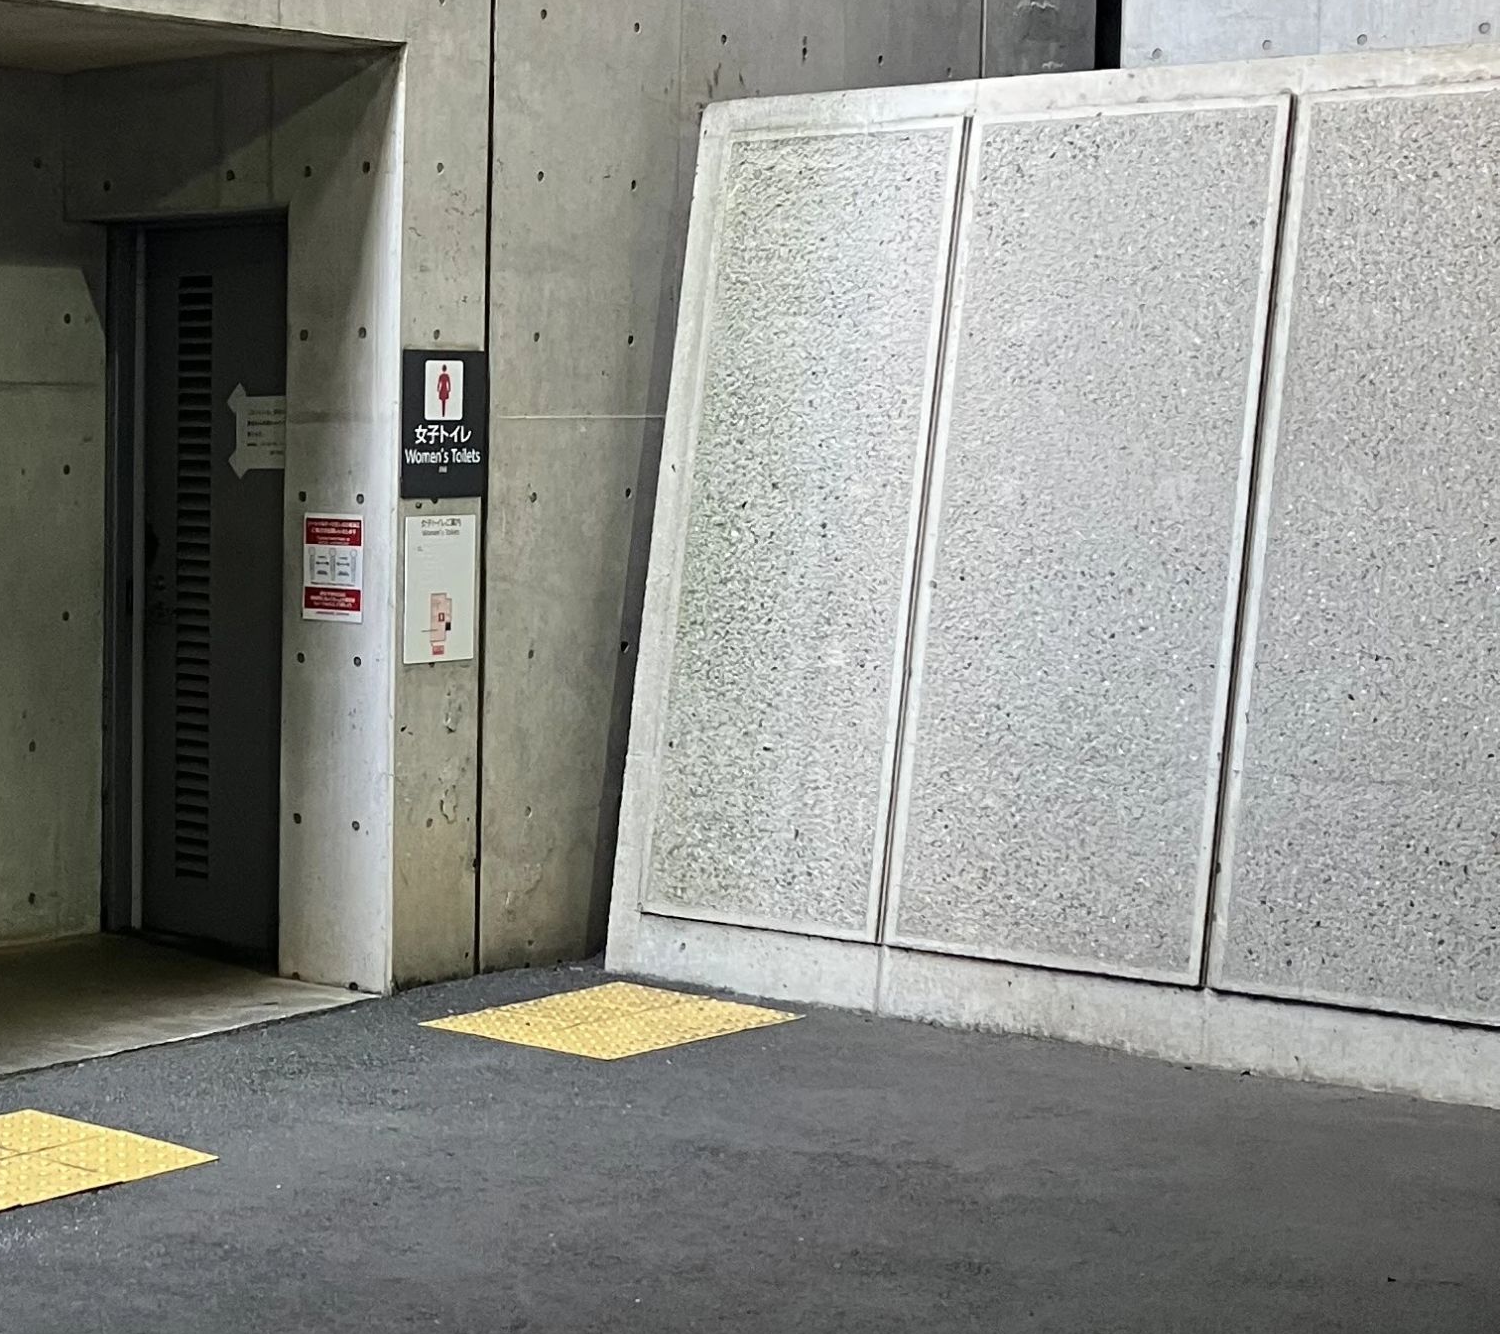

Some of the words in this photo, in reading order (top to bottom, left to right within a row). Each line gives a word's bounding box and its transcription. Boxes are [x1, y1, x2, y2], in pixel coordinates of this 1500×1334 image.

[414, 424, 472, 444] 女子トイレ
[404, 447, 449, 464] Women's
[450, 448, 481, 463] Toilets
